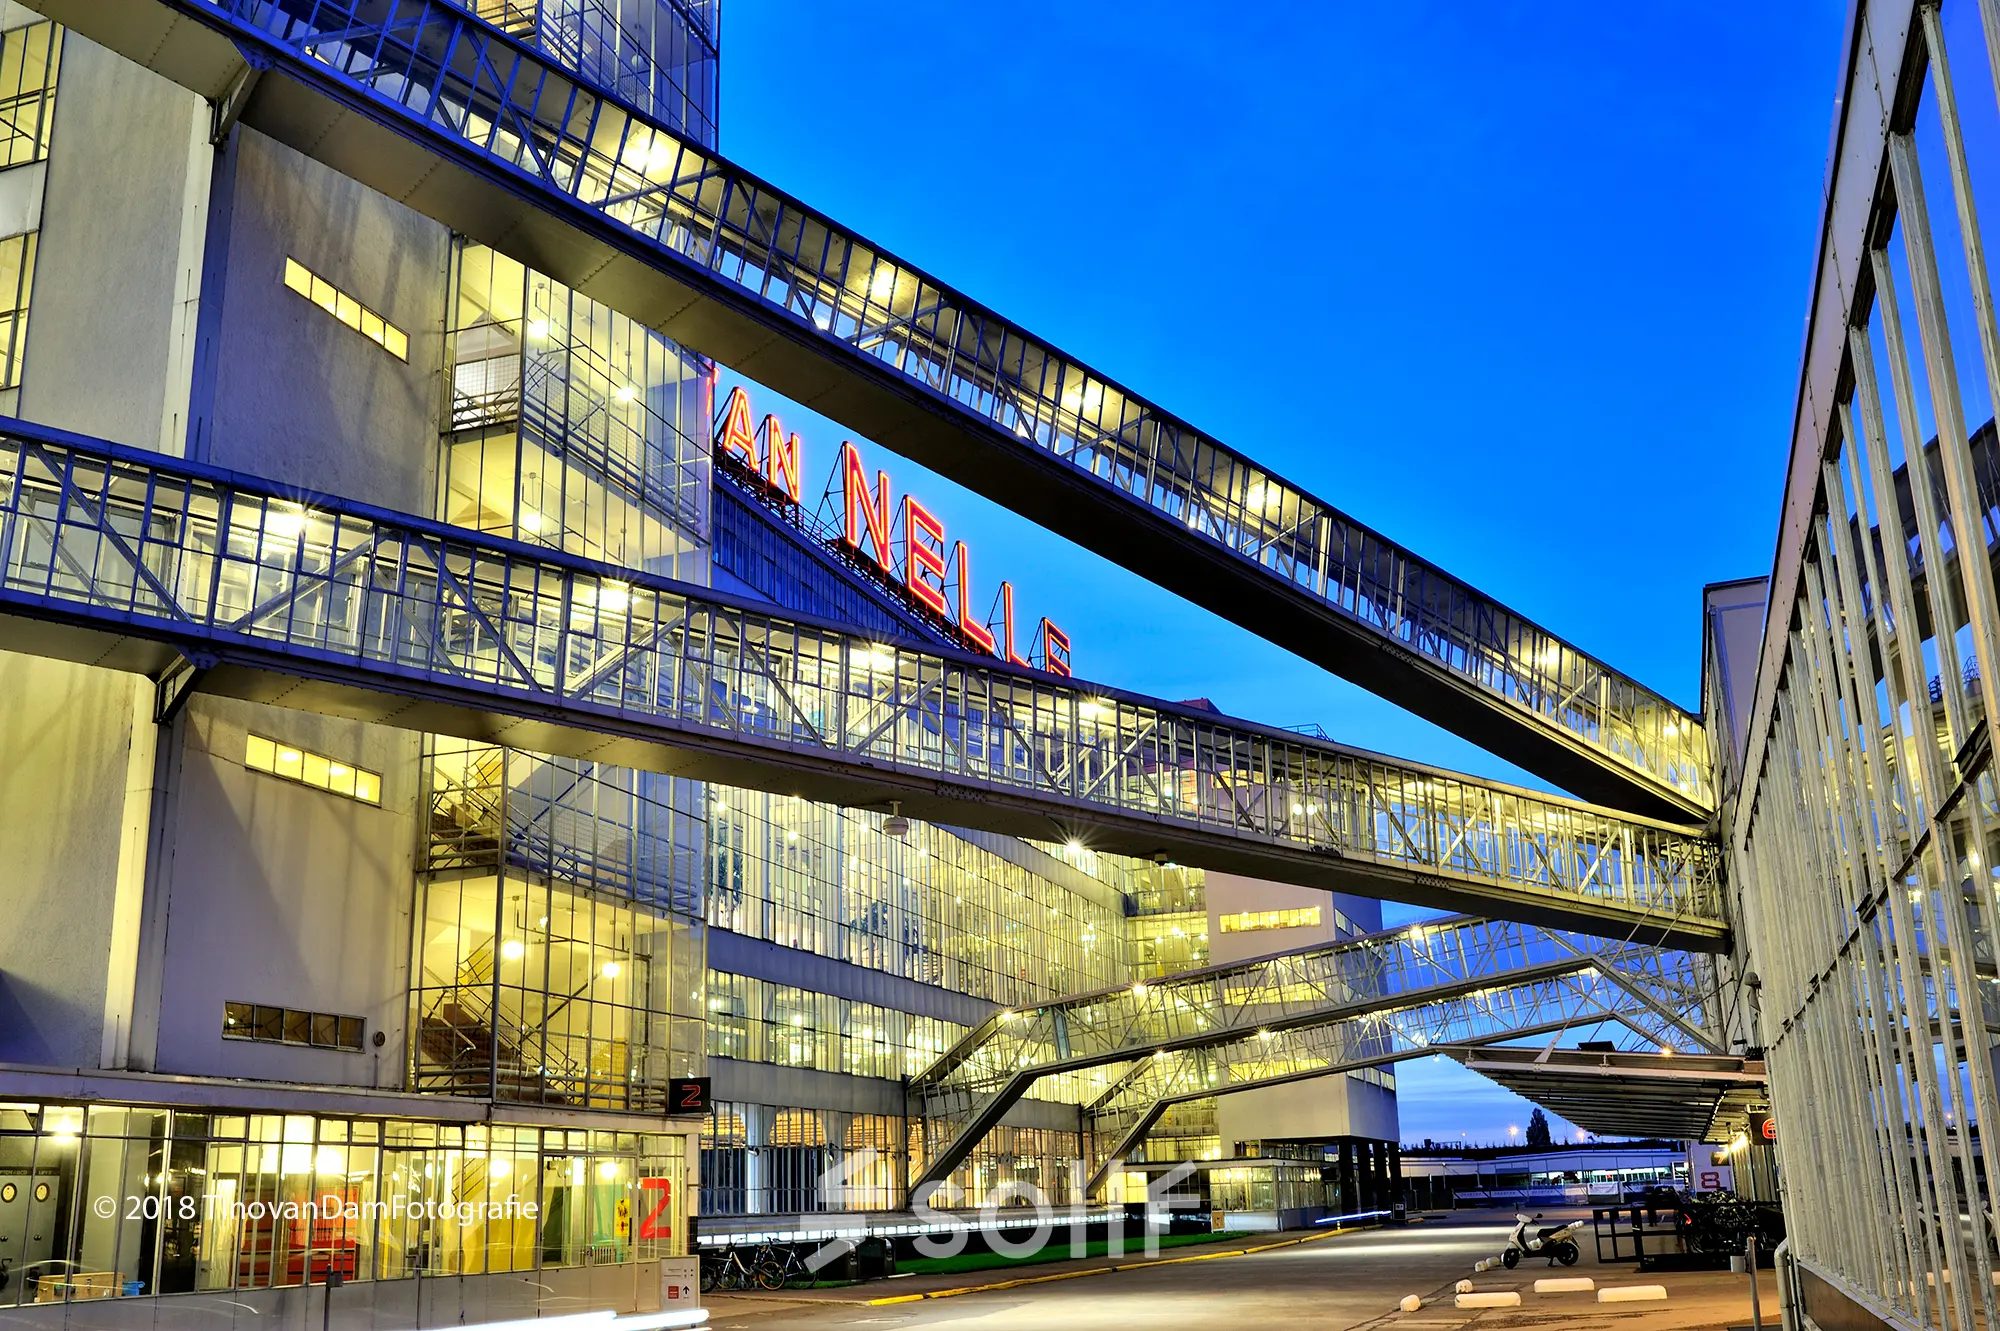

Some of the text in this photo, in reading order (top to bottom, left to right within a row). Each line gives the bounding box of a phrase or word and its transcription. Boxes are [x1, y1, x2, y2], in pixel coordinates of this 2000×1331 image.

[844, 441, 1072, 678] NELLE
[681, 1084, 702, 1107] 2
[1701, 1172, 1720, 1188] 8
[640, 1177, 672, 1239] 2
